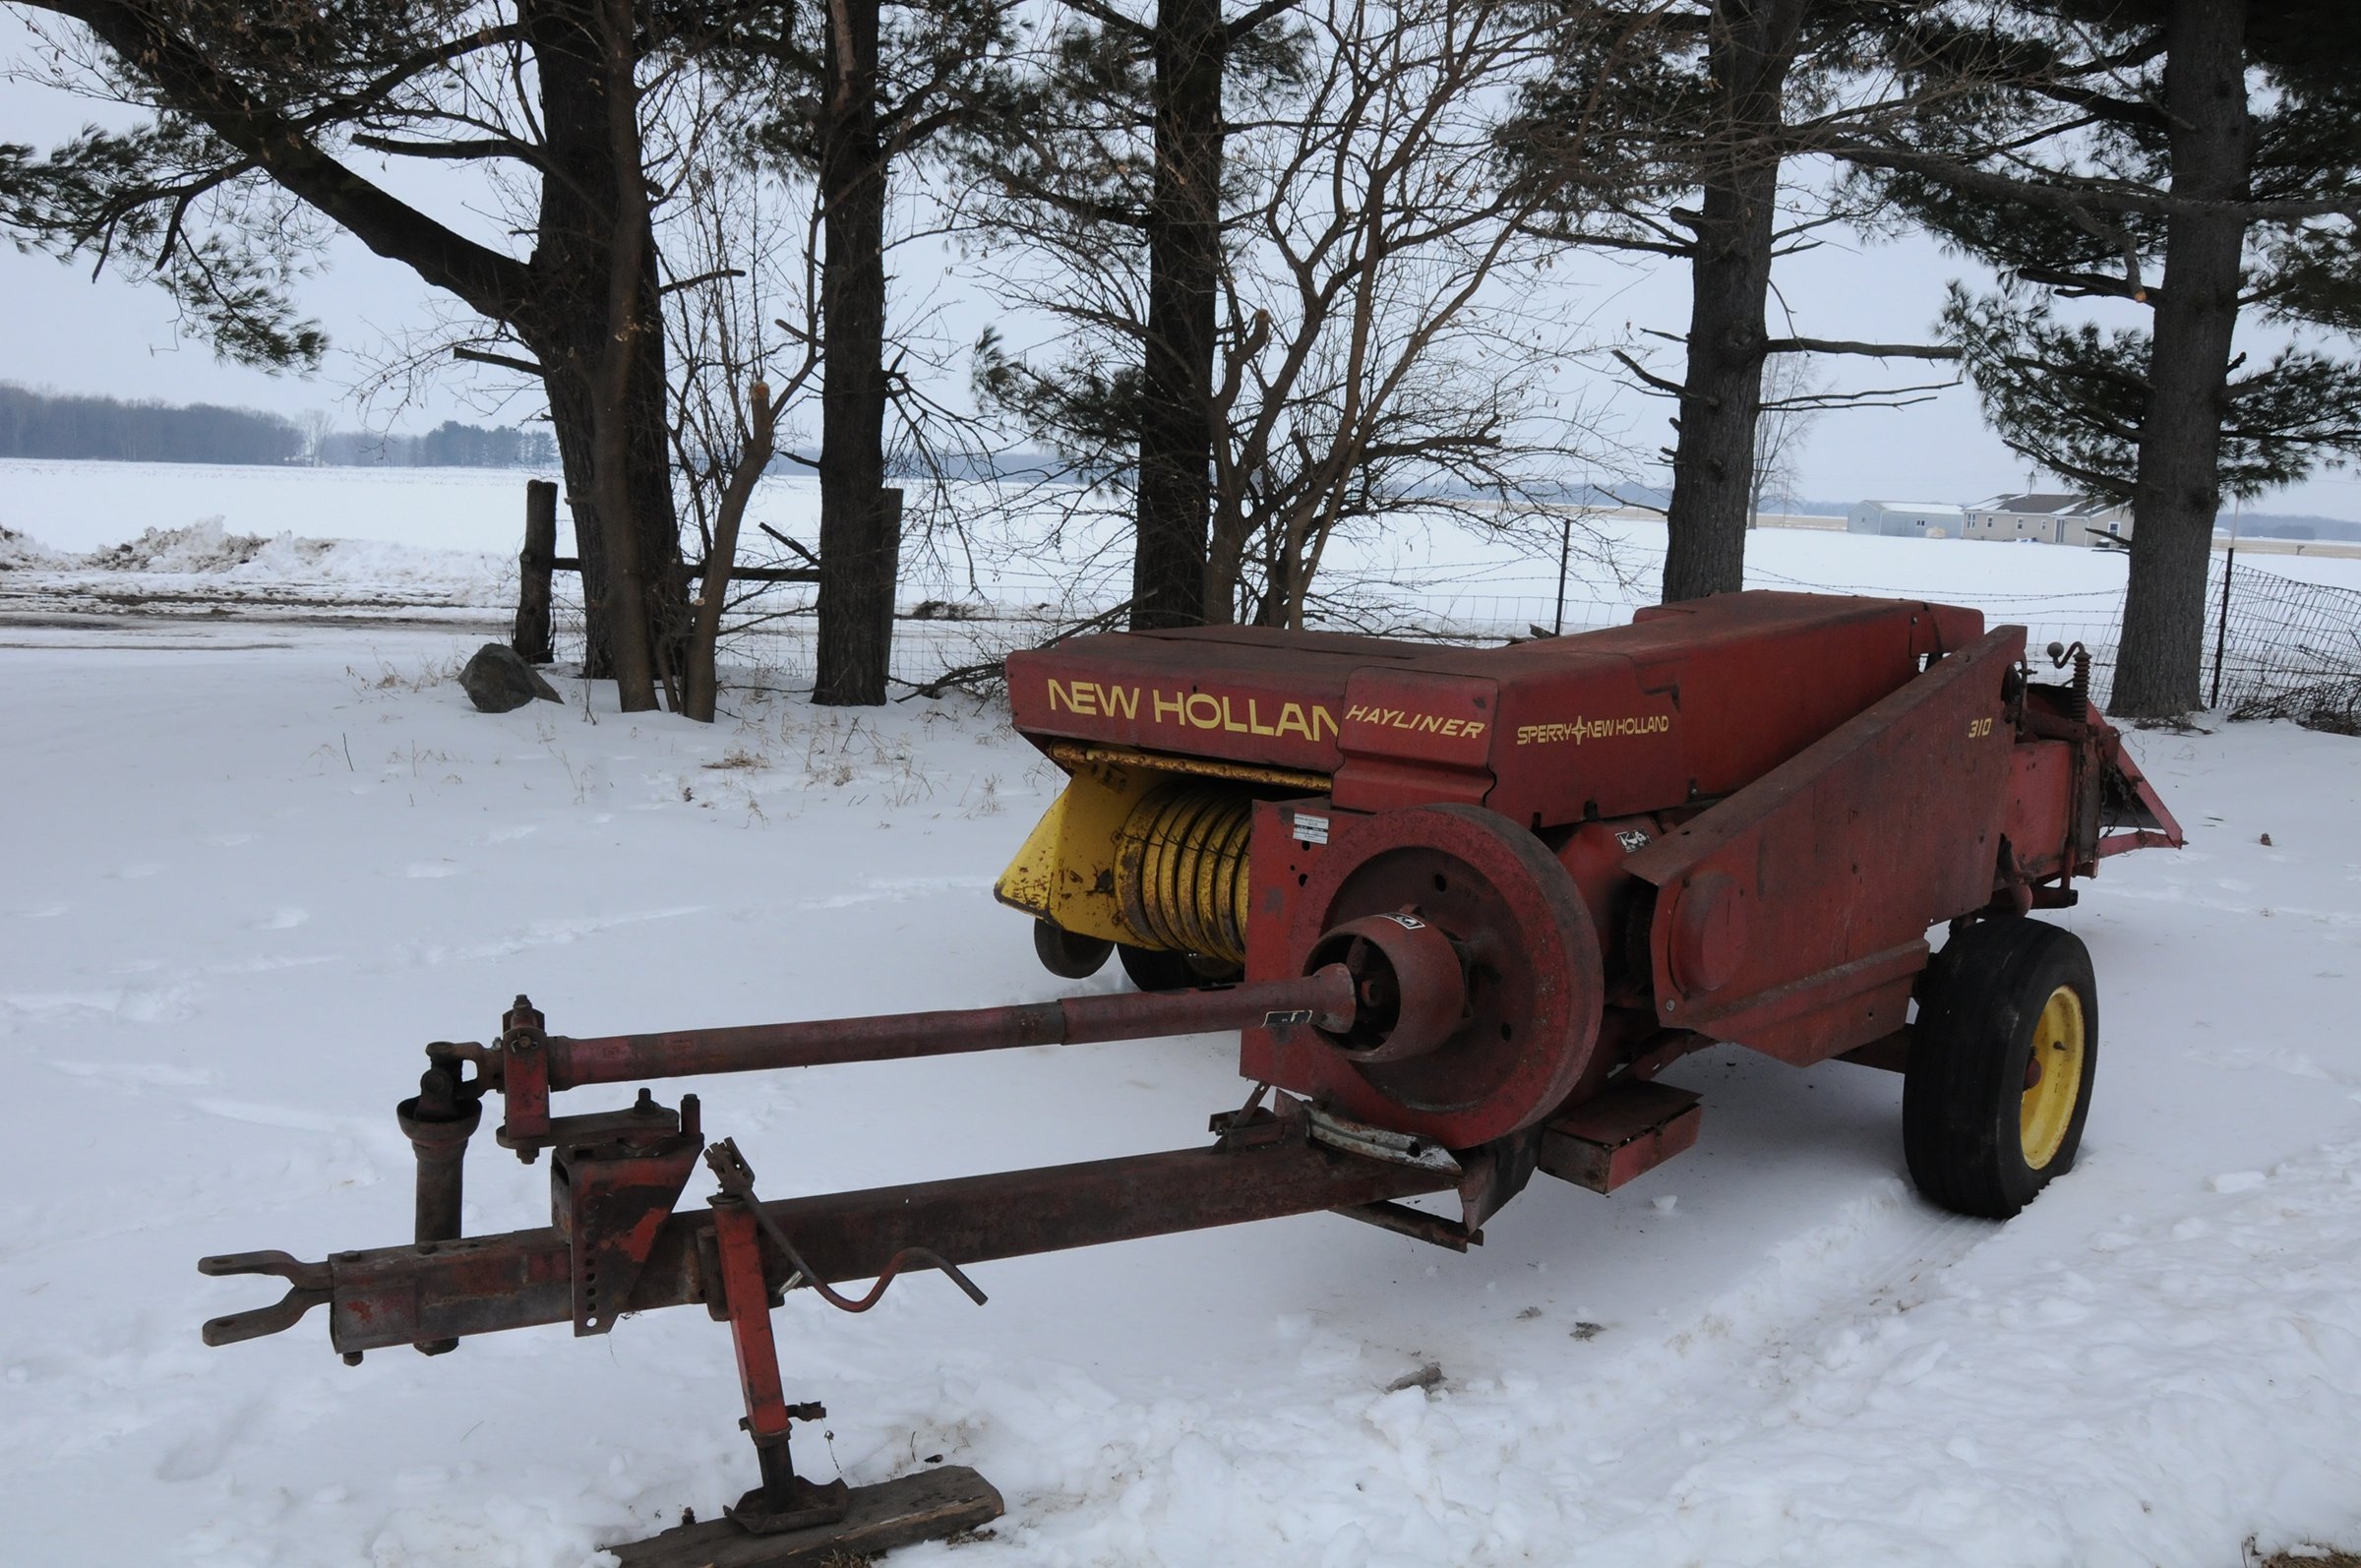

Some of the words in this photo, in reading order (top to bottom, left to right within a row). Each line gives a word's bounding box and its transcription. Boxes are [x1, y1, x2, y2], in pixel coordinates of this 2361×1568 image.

[1048, 679, 1140, 720] NEW
[1153, 690, 1340, 742] HOLLAN
[1345, 704, 1486, 739] HAYLINER
[1517, 723, 1573, 746] SPERRY
[1587, 719, 1615, 738] NEW
[1615, 715, 1669, 736] HOLLAND
[1968, 718, 1992, 738] 310
